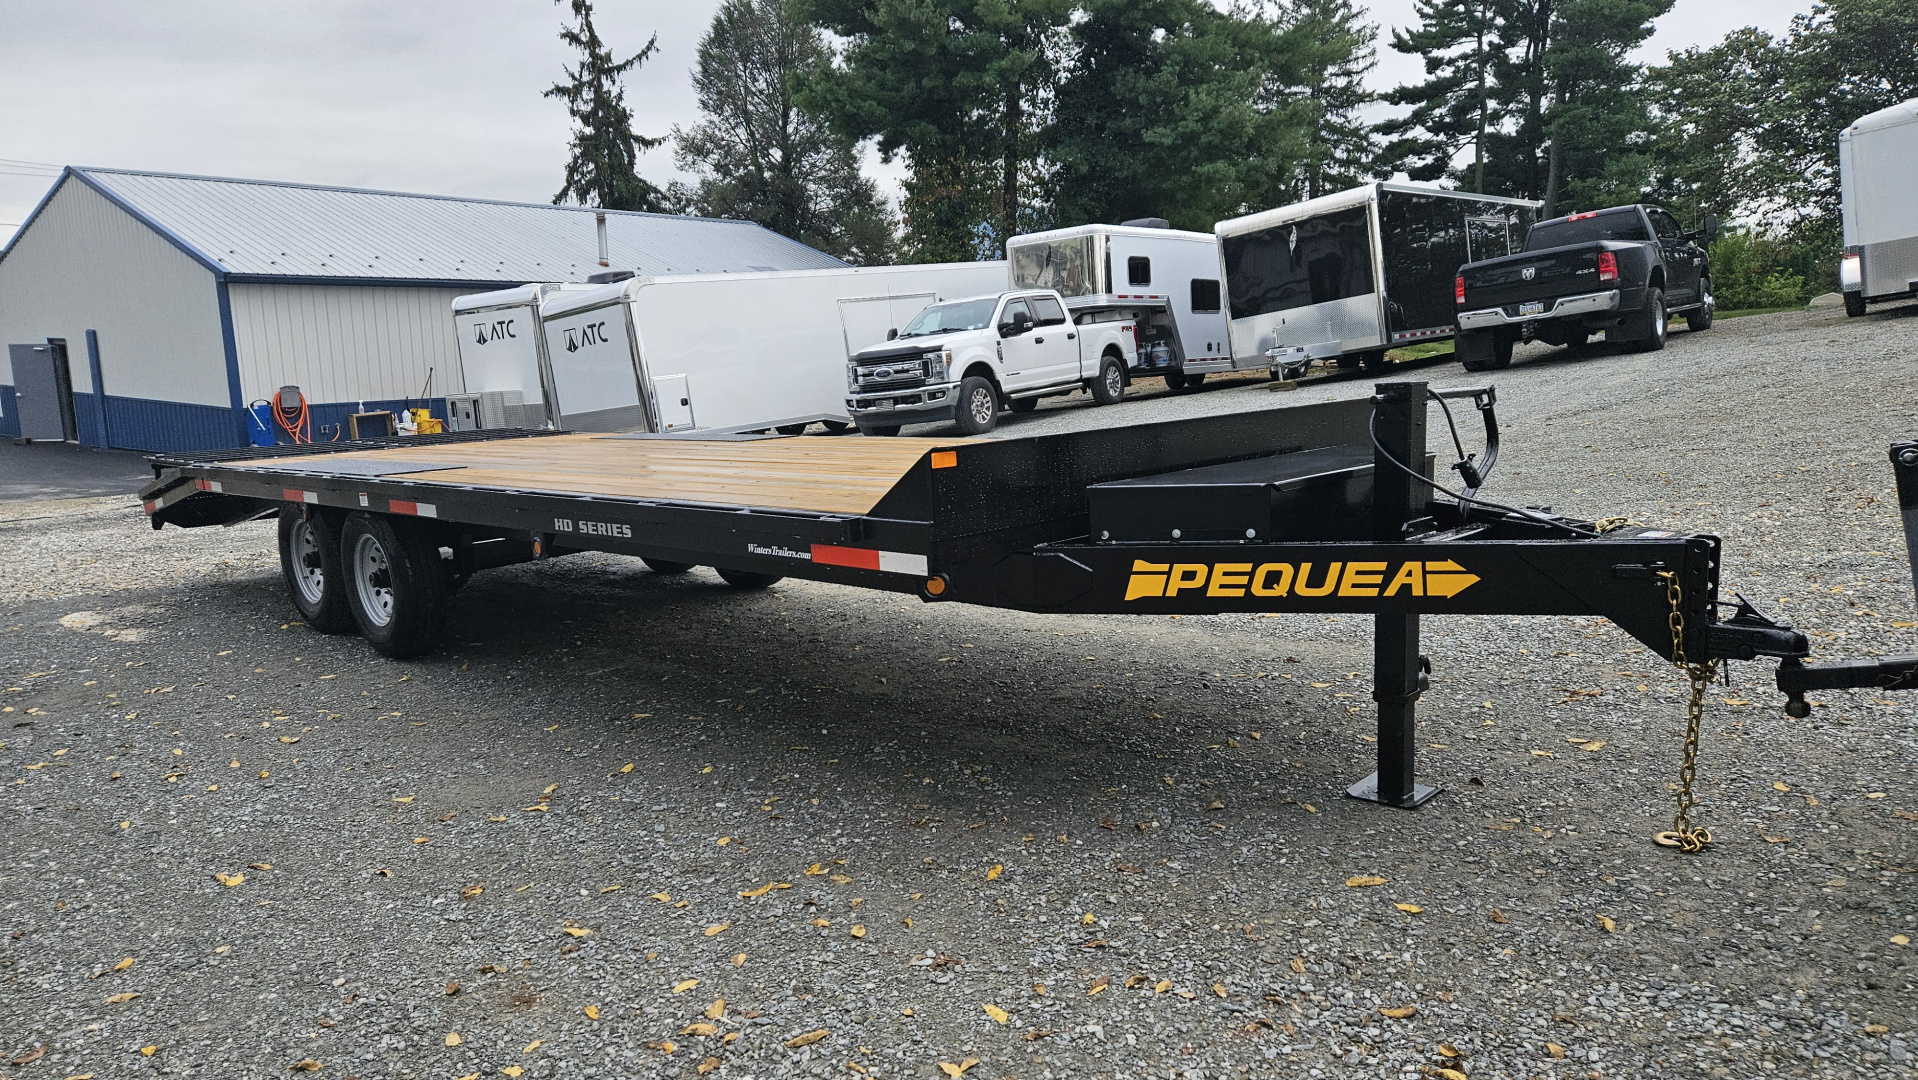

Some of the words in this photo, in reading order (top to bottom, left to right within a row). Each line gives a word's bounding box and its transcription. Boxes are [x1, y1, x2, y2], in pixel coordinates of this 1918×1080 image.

[490, 319, 516, 341] ATC
[581, 321, 609, 347] ATC
[554, 518, 573, 532] HD
[578, 520, 632, 538] SERIES
[747, 543, 812, 560] WintersTrailers.com
[1164, 561, 1424, 598] PEQUEA
